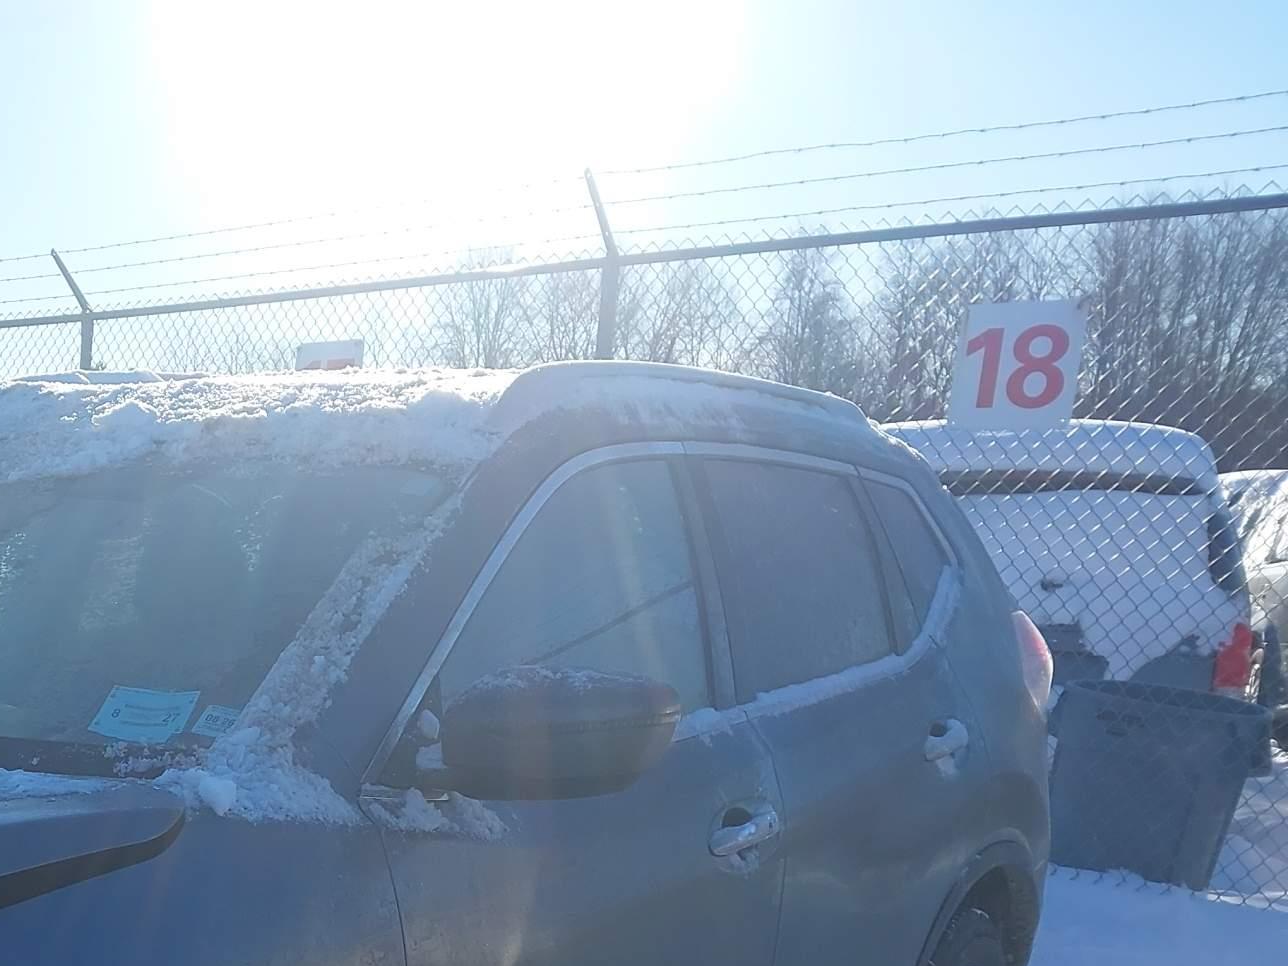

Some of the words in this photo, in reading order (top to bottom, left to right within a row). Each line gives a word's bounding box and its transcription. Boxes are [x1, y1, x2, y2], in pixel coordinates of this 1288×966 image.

[966, 323, 1070, 410] 18
[111, 708, 121, 718] 8
[162, 711, 181, 723] 27
